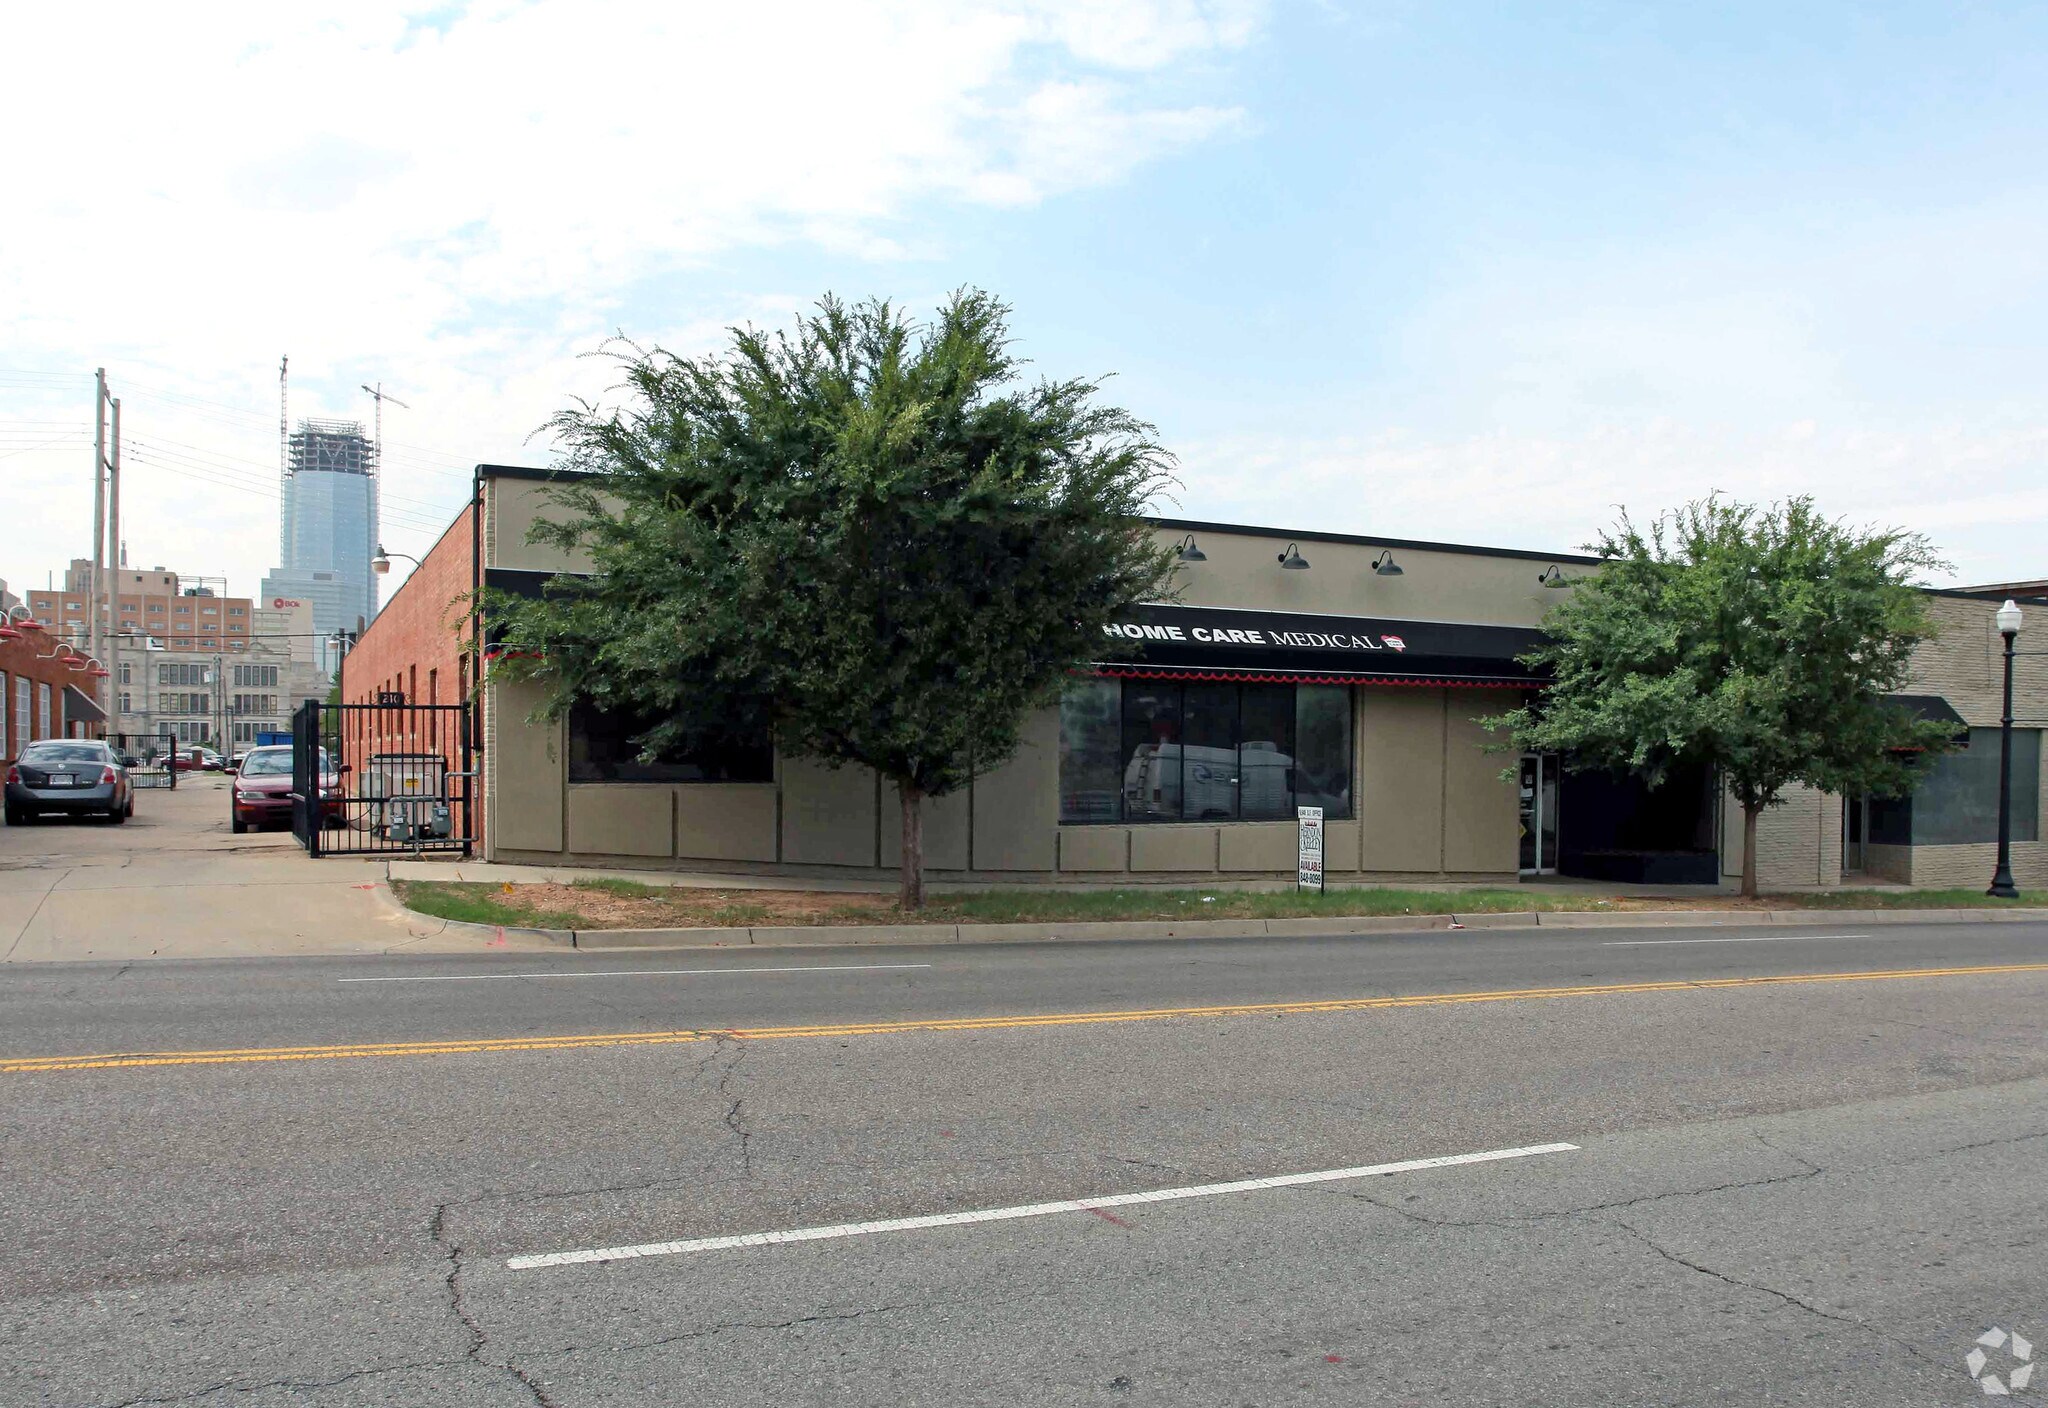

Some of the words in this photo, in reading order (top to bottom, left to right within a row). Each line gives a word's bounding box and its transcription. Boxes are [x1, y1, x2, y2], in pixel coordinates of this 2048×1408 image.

[1102, 622, 1187, 641] HOME
[1192, 627, 1267, 645] CARE
[1268, 630, 1382, 650] MEDICAL
[1300, 860, 1321, 872] AVAILABLE
